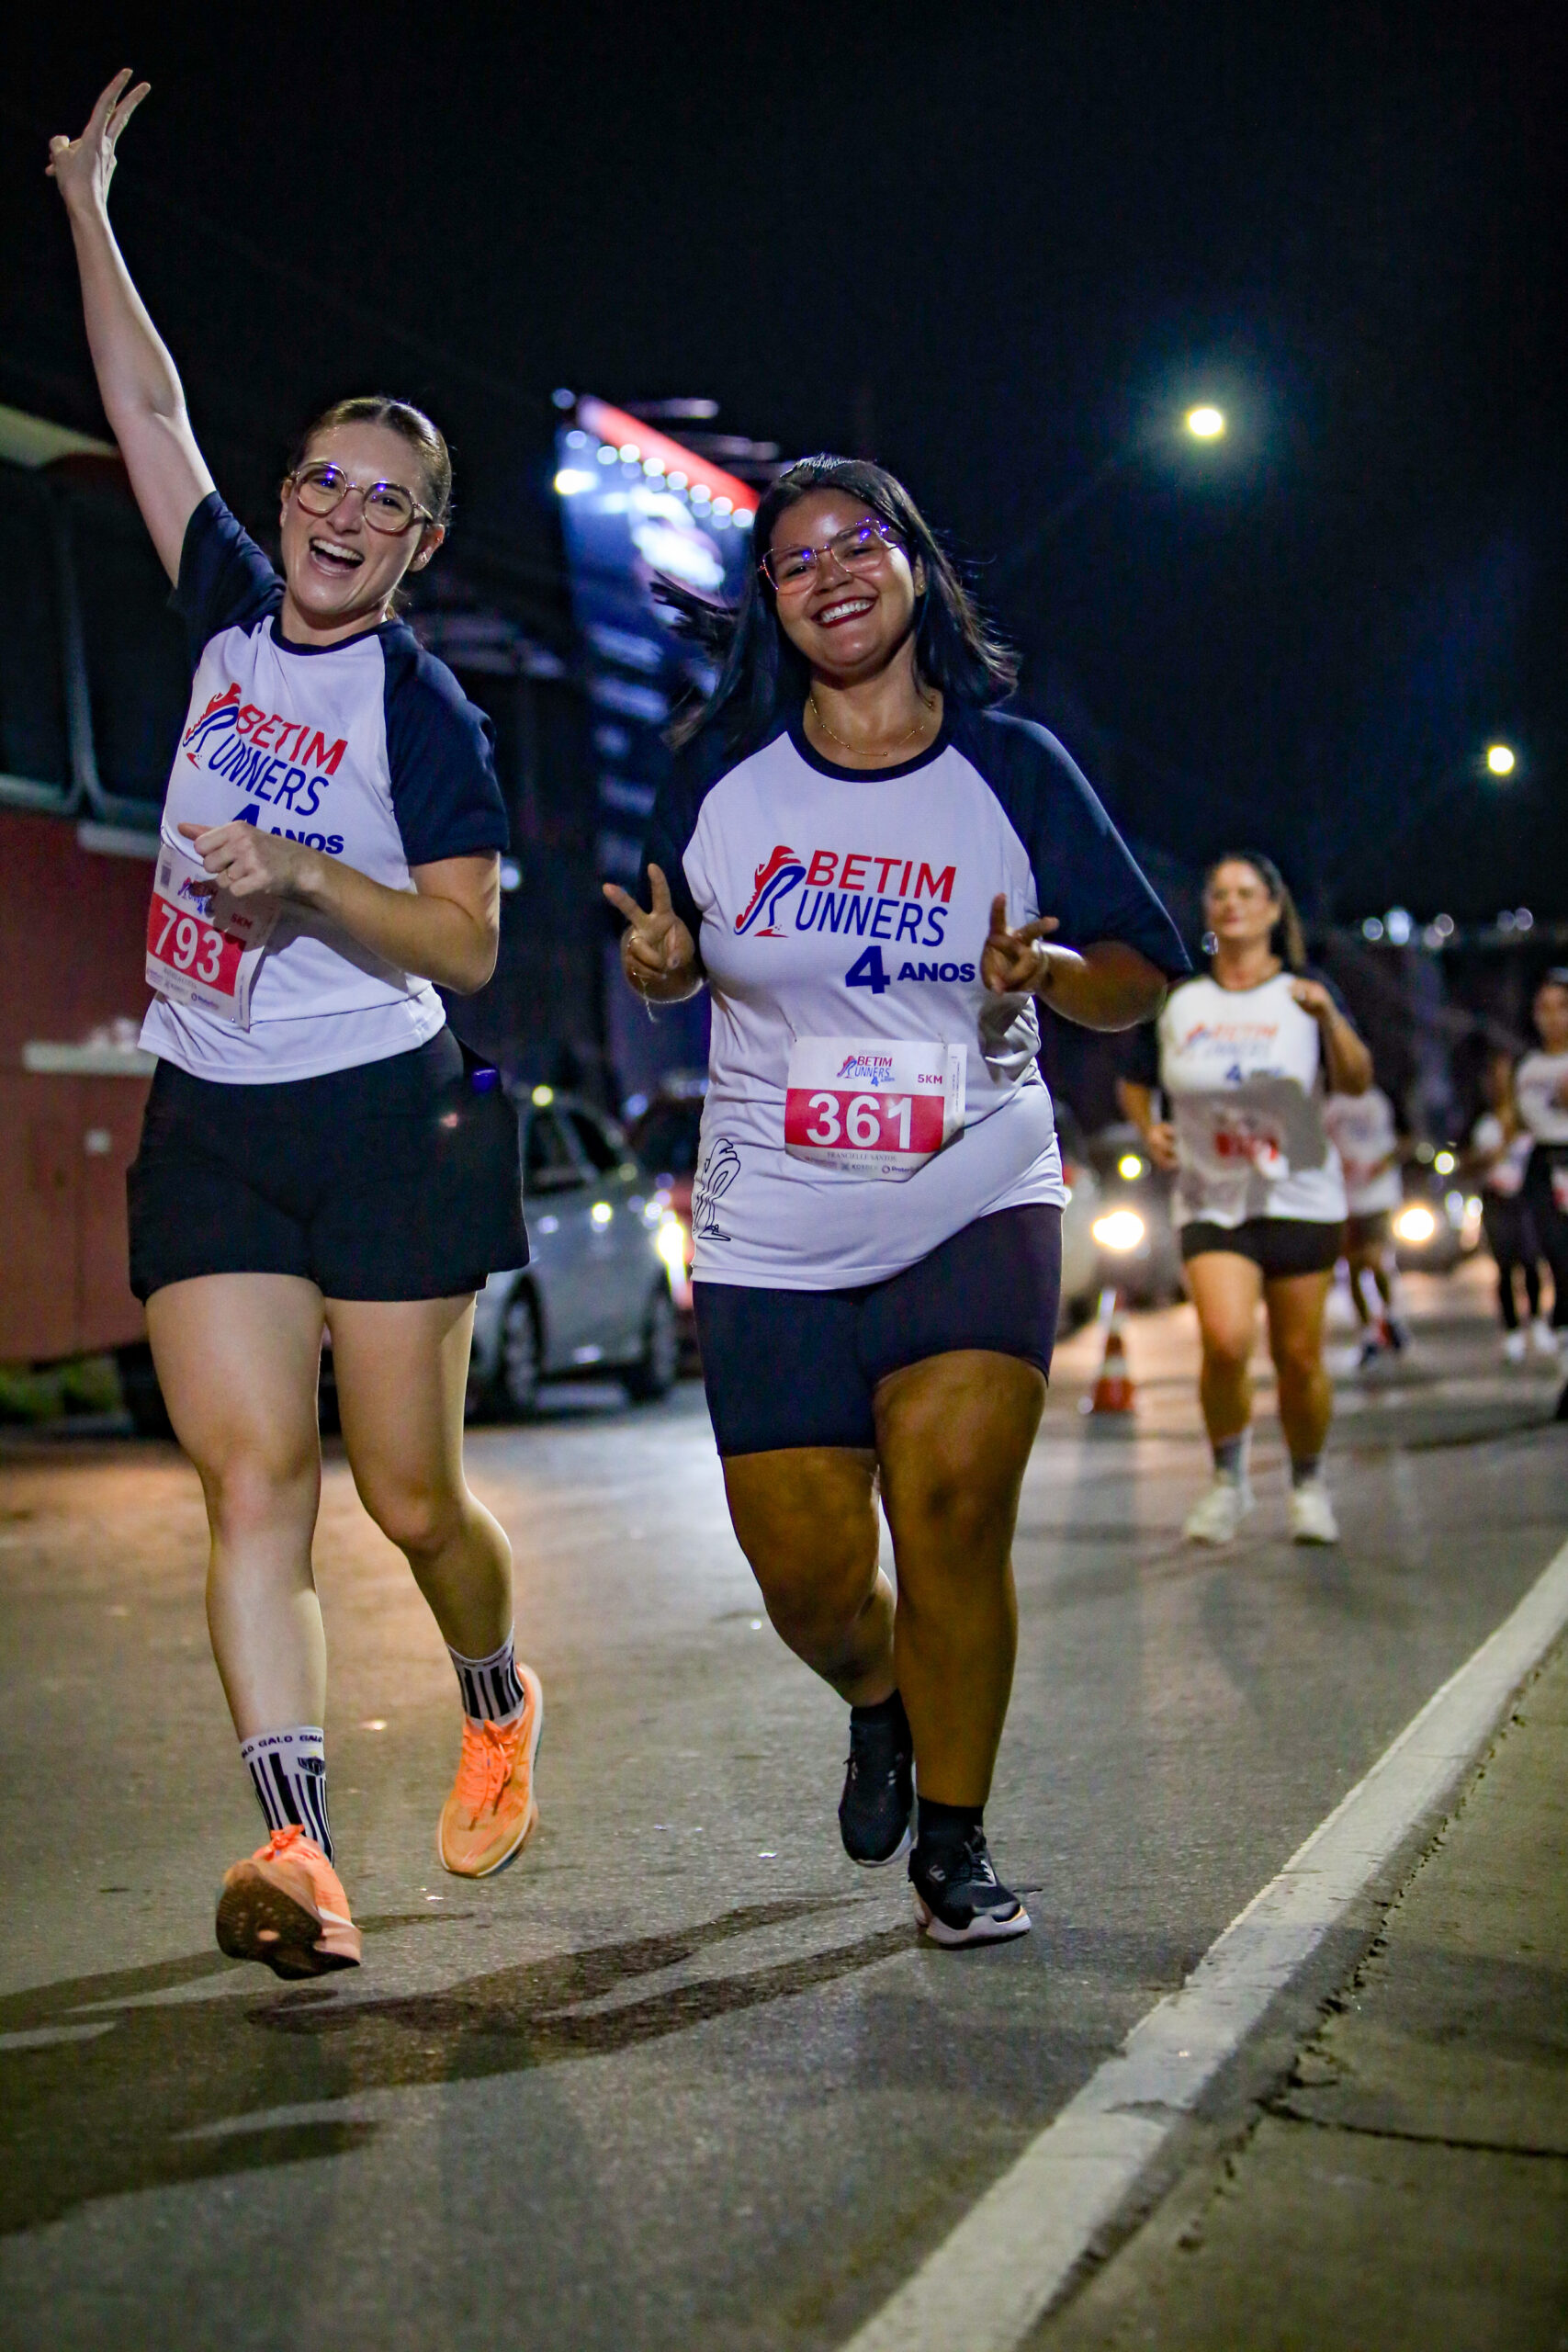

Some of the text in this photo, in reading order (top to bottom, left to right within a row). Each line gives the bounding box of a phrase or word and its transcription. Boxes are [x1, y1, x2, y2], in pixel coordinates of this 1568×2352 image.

[236, 704, 348, 775] BETIM
[806, 850, 956, 903] BETIM
[155, 903, 223, 983] 793
[845, 945, 976, 994] 4 ANOS
[857, 1056, 893, 1068] BETIM
[918, 1074, 942, 1084] 5KM
[807, 1093, 912, 1149] 361
